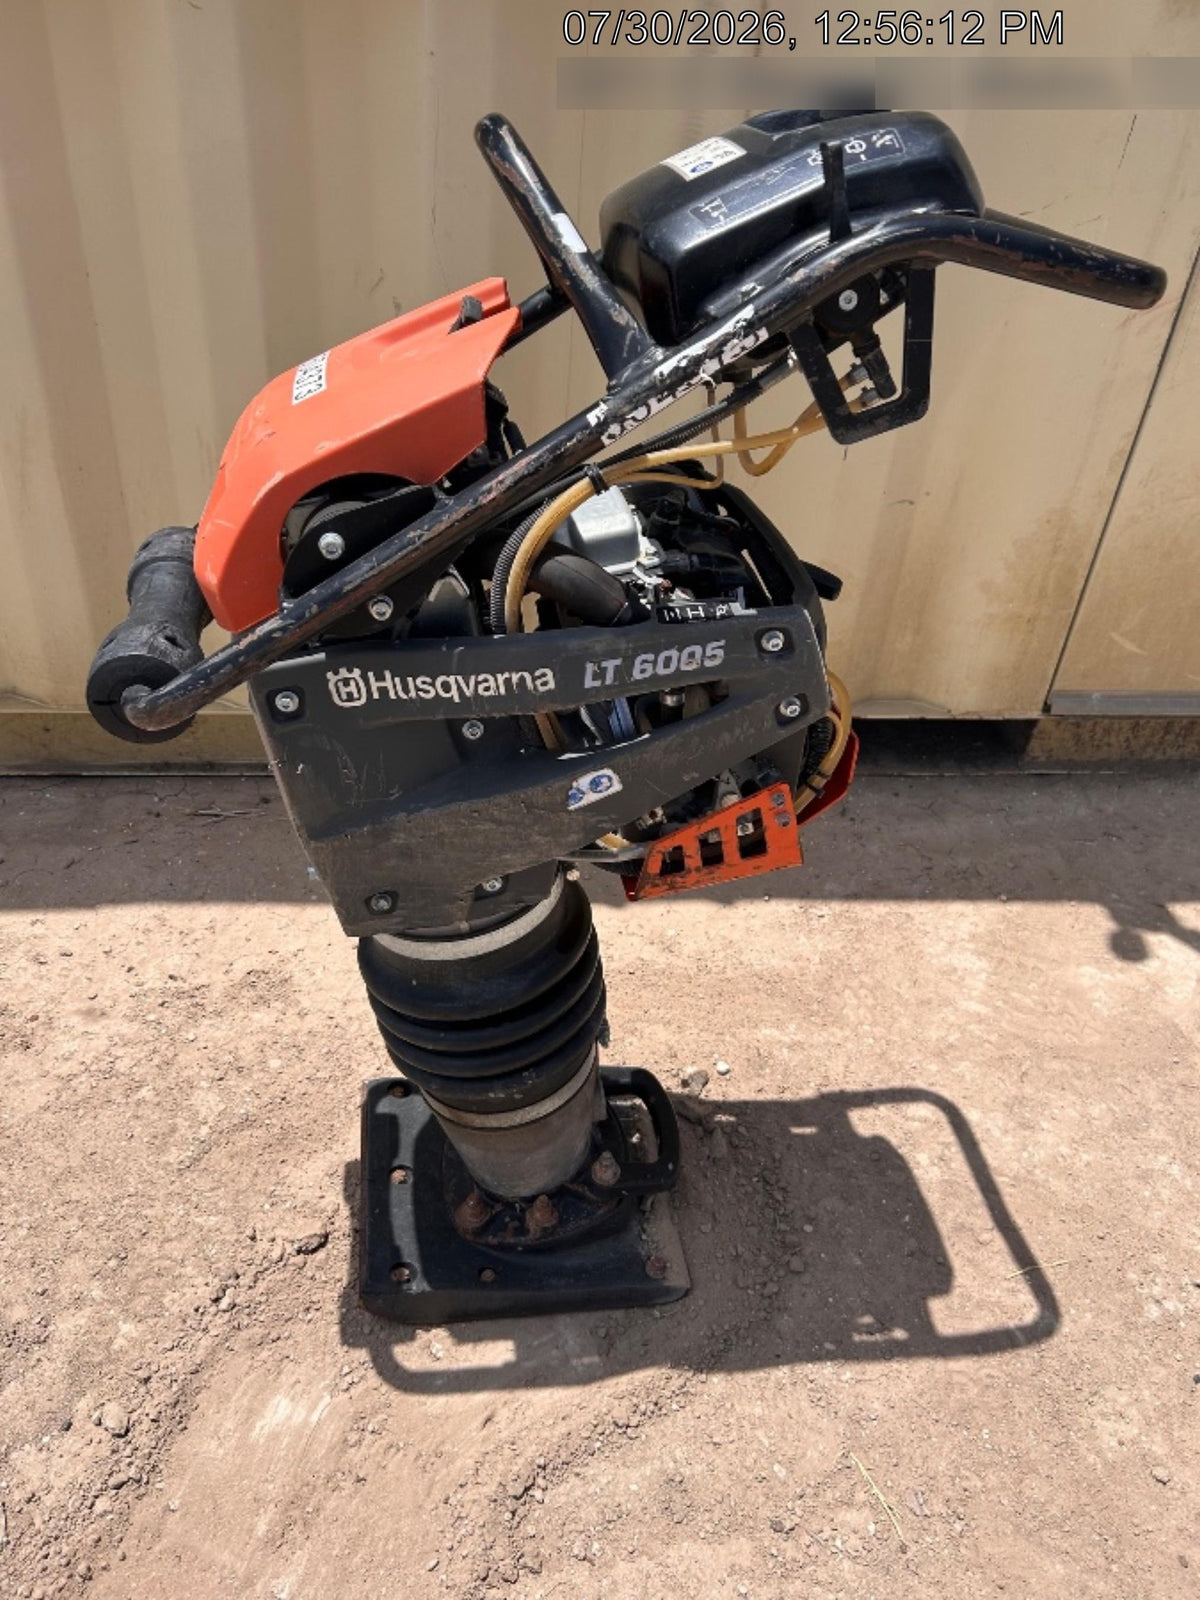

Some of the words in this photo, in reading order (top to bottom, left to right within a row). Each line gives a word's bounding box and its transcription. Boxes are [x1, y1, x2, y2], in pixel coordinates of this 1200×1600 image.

[367, 667, 556, 703] Husqvarna
[584, 658, 622, 689] LT
[631, 640, 727, 680] 6005
